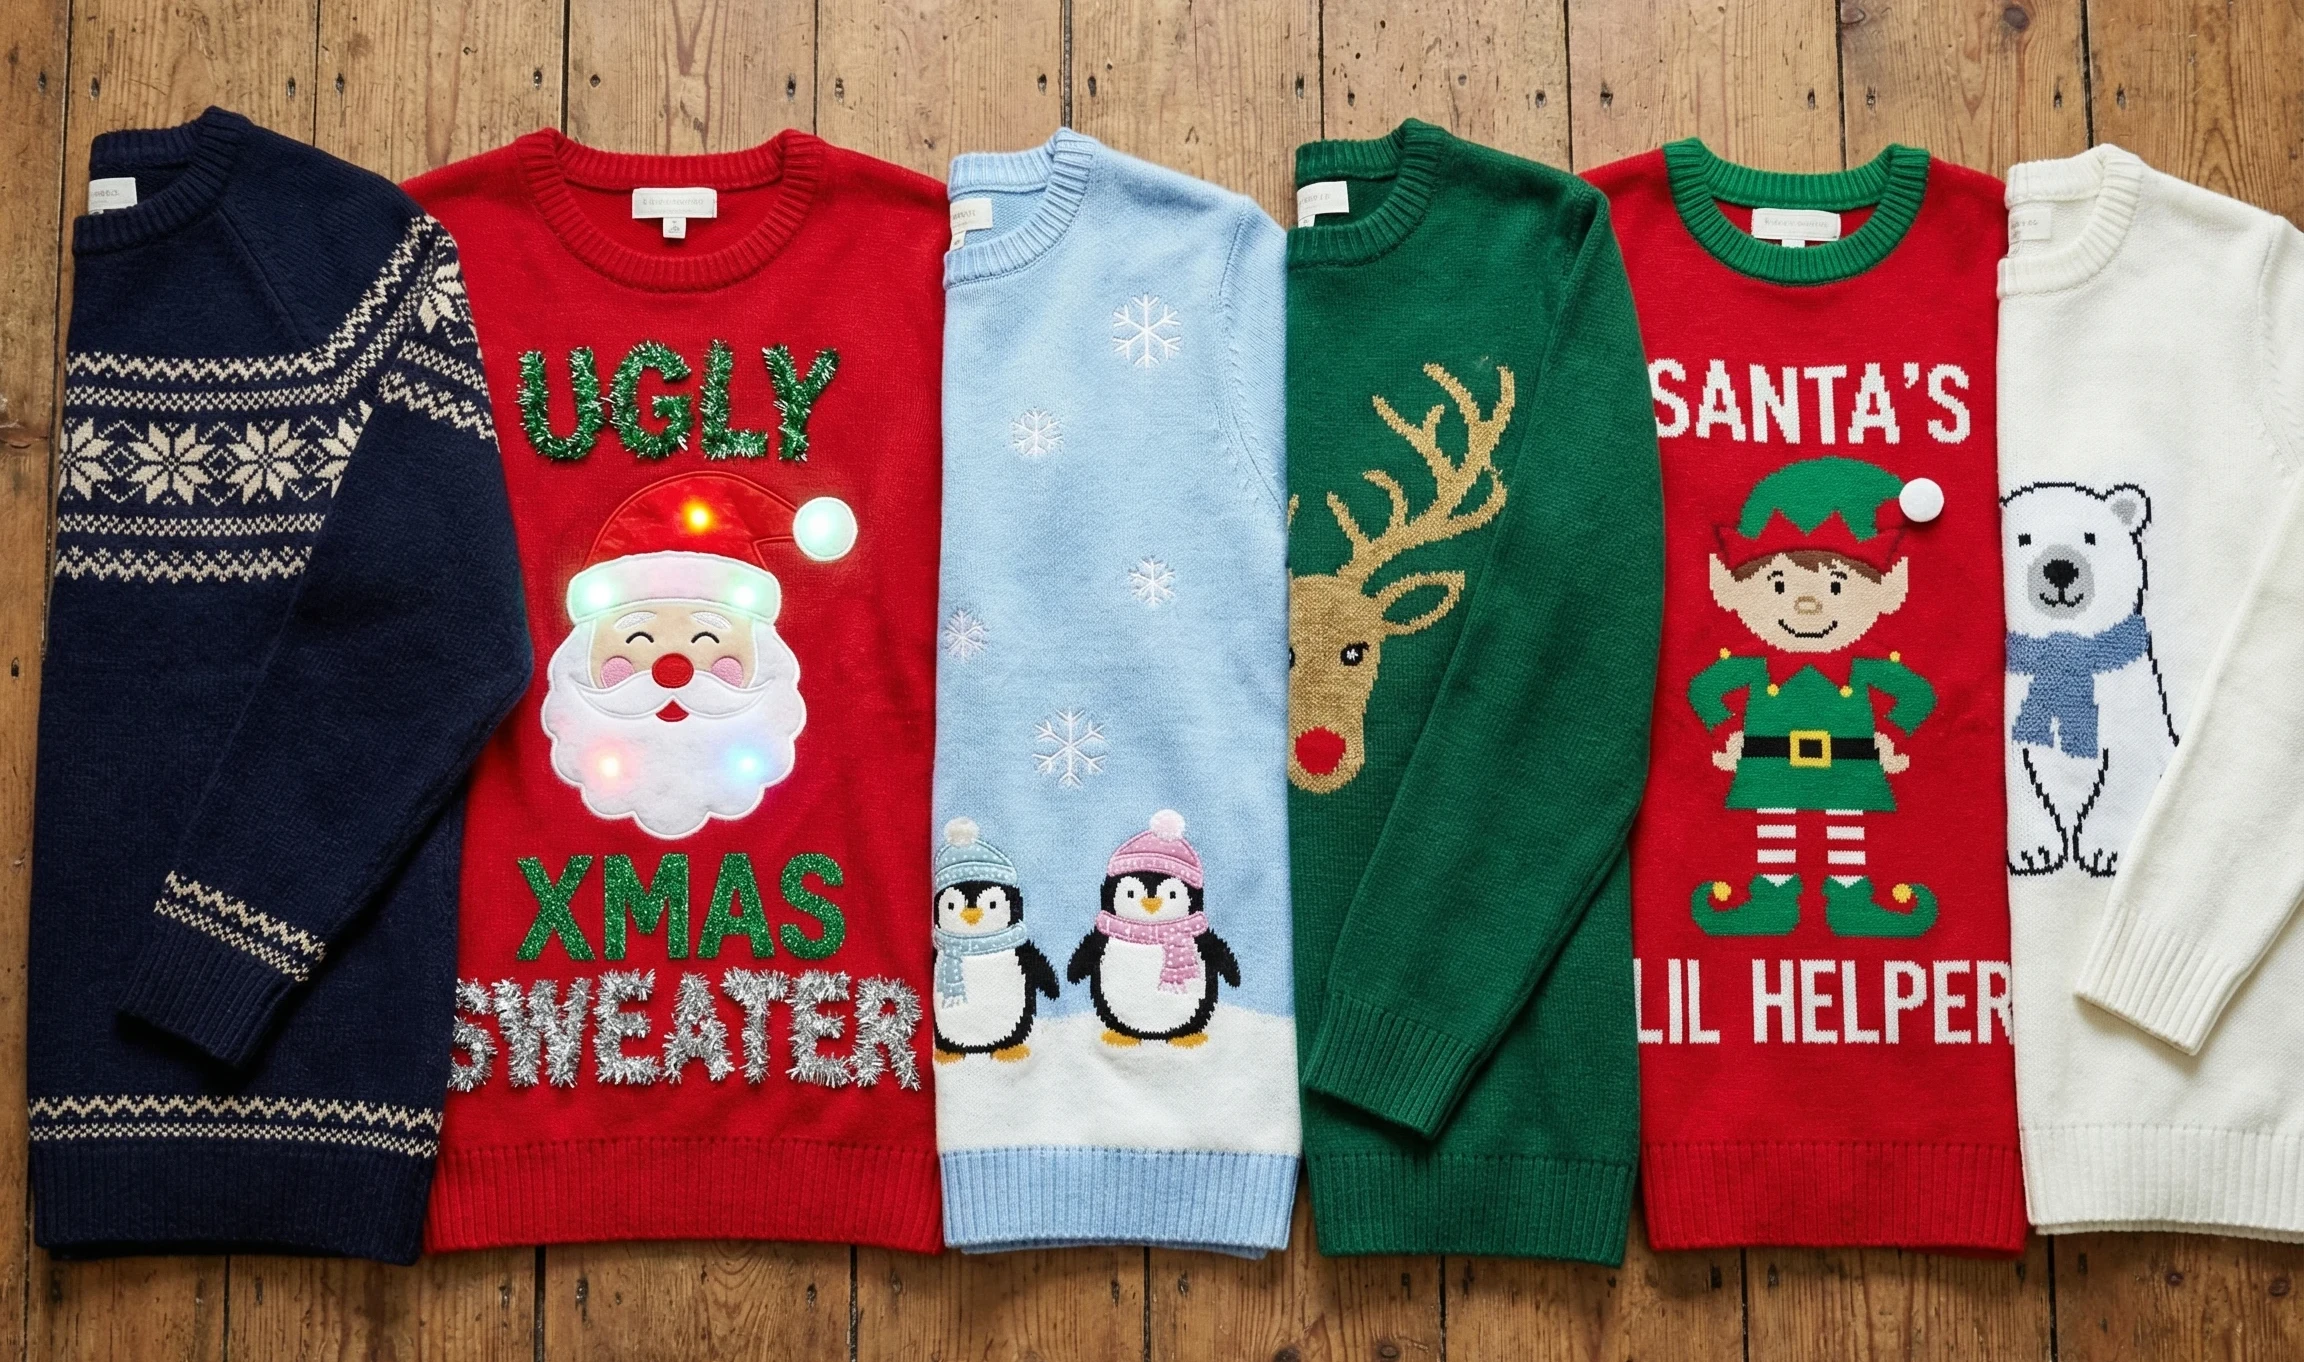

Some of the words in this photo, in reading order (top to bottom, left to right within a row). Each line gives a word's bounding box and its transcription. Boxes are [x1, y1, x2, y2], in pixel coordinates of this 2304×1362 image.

[517, 341, 840, 462] UGLY
[1648, 358, 1971, 445] SANTA'S
[516, 852, 846, 961] XMAS
[447, 967, 923, 1092] SWEATER
[1633, 958, 1720, 1045] LIL
[1751, 958, 2014, 1046] HELPER
